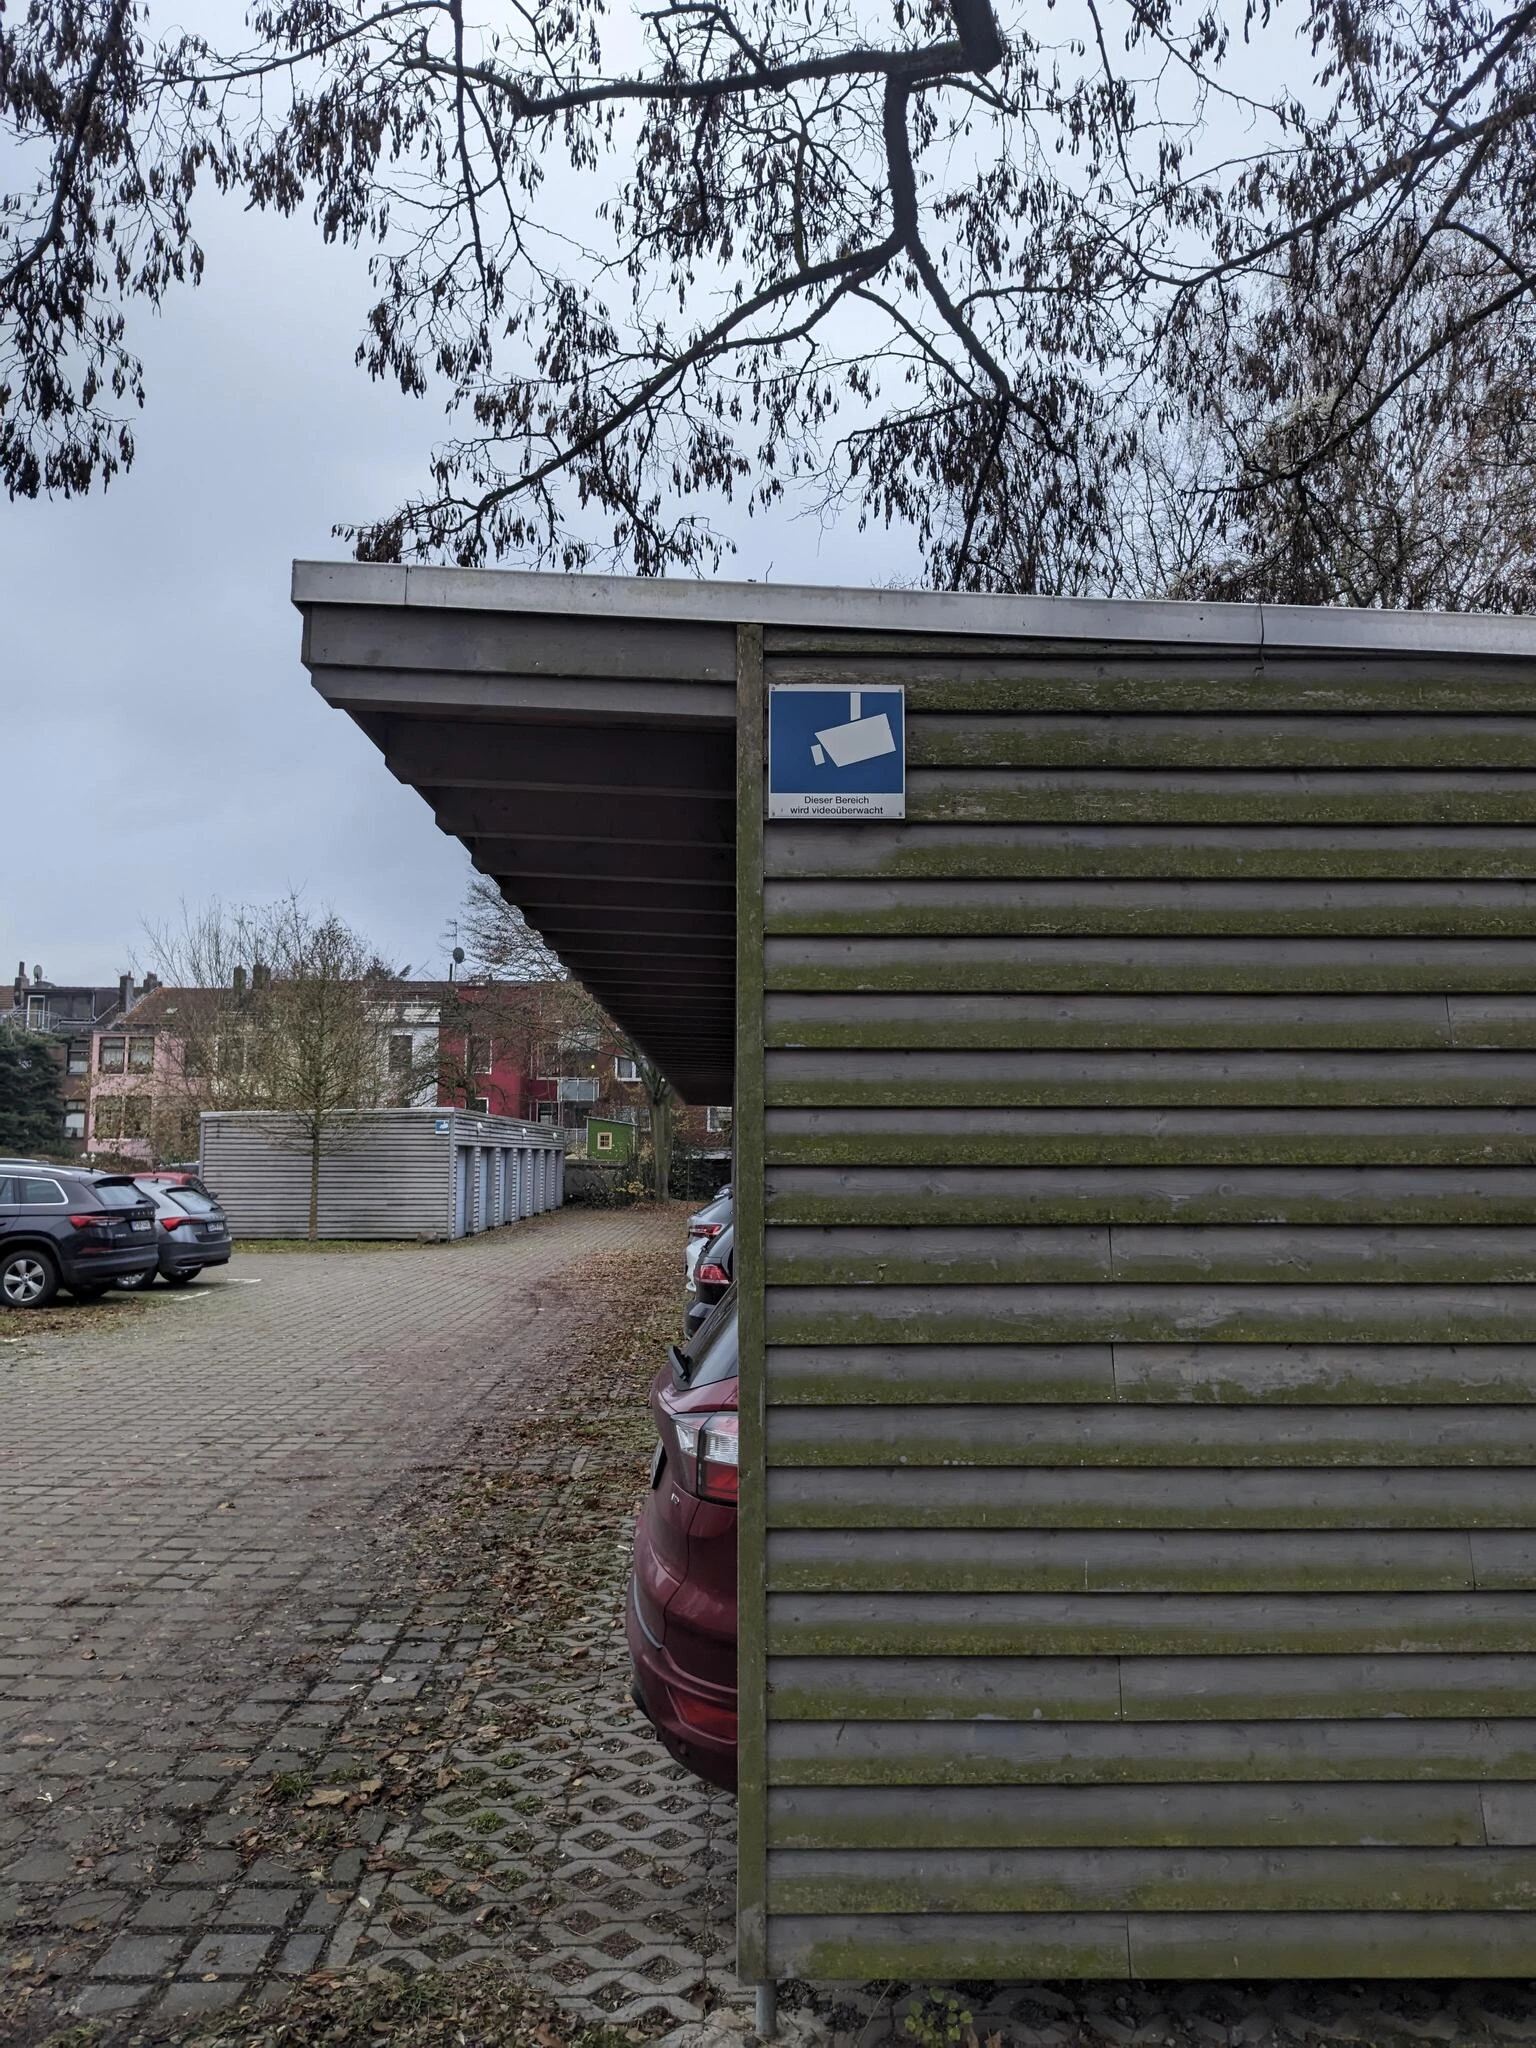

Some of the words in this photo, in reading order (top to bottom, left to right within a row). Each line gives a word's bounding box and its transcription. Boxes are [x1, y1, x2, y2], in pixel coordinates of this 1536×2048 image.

[804, 796, 833, 804] Dieser
[835, 796, 870, 804] Bereich
[790, 806, 810, 814] wird
[811, 806, 884, 814] videoüberwacht
